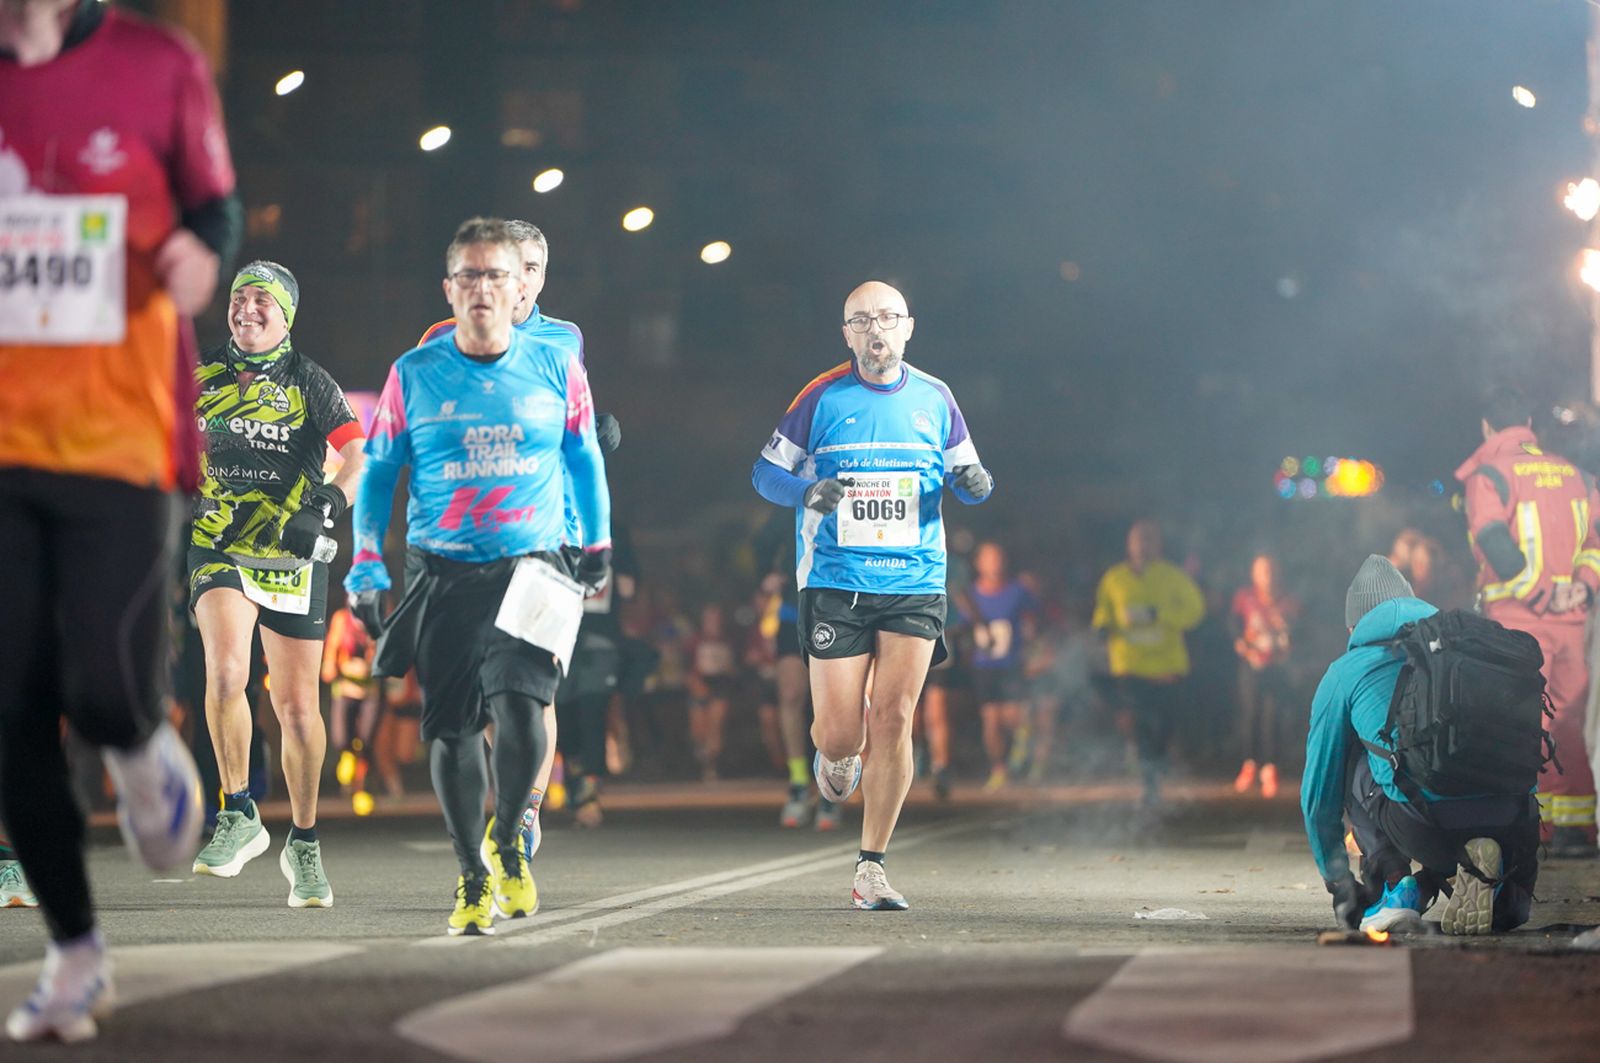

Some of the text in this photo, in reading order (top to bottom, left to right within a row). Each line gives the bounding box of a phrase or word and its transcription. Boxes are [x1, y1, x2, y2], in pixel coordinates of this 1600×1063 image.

[463, 423, 525, 444] ADRA
[250, 439, 289, 454] TRAIL
[466, 441, 520, 461] TRAIL
[444, 457, 540, 480] RUNNING
[840, 459, 858, 469] Club
[860, 458, 872, 468] de
[873, 457, 913, 469] Atletismo
[856, 480, 880, 488] NOCHE
[847, 489, 863, 498] SAN
[852, 499, 906, 521] 6069
